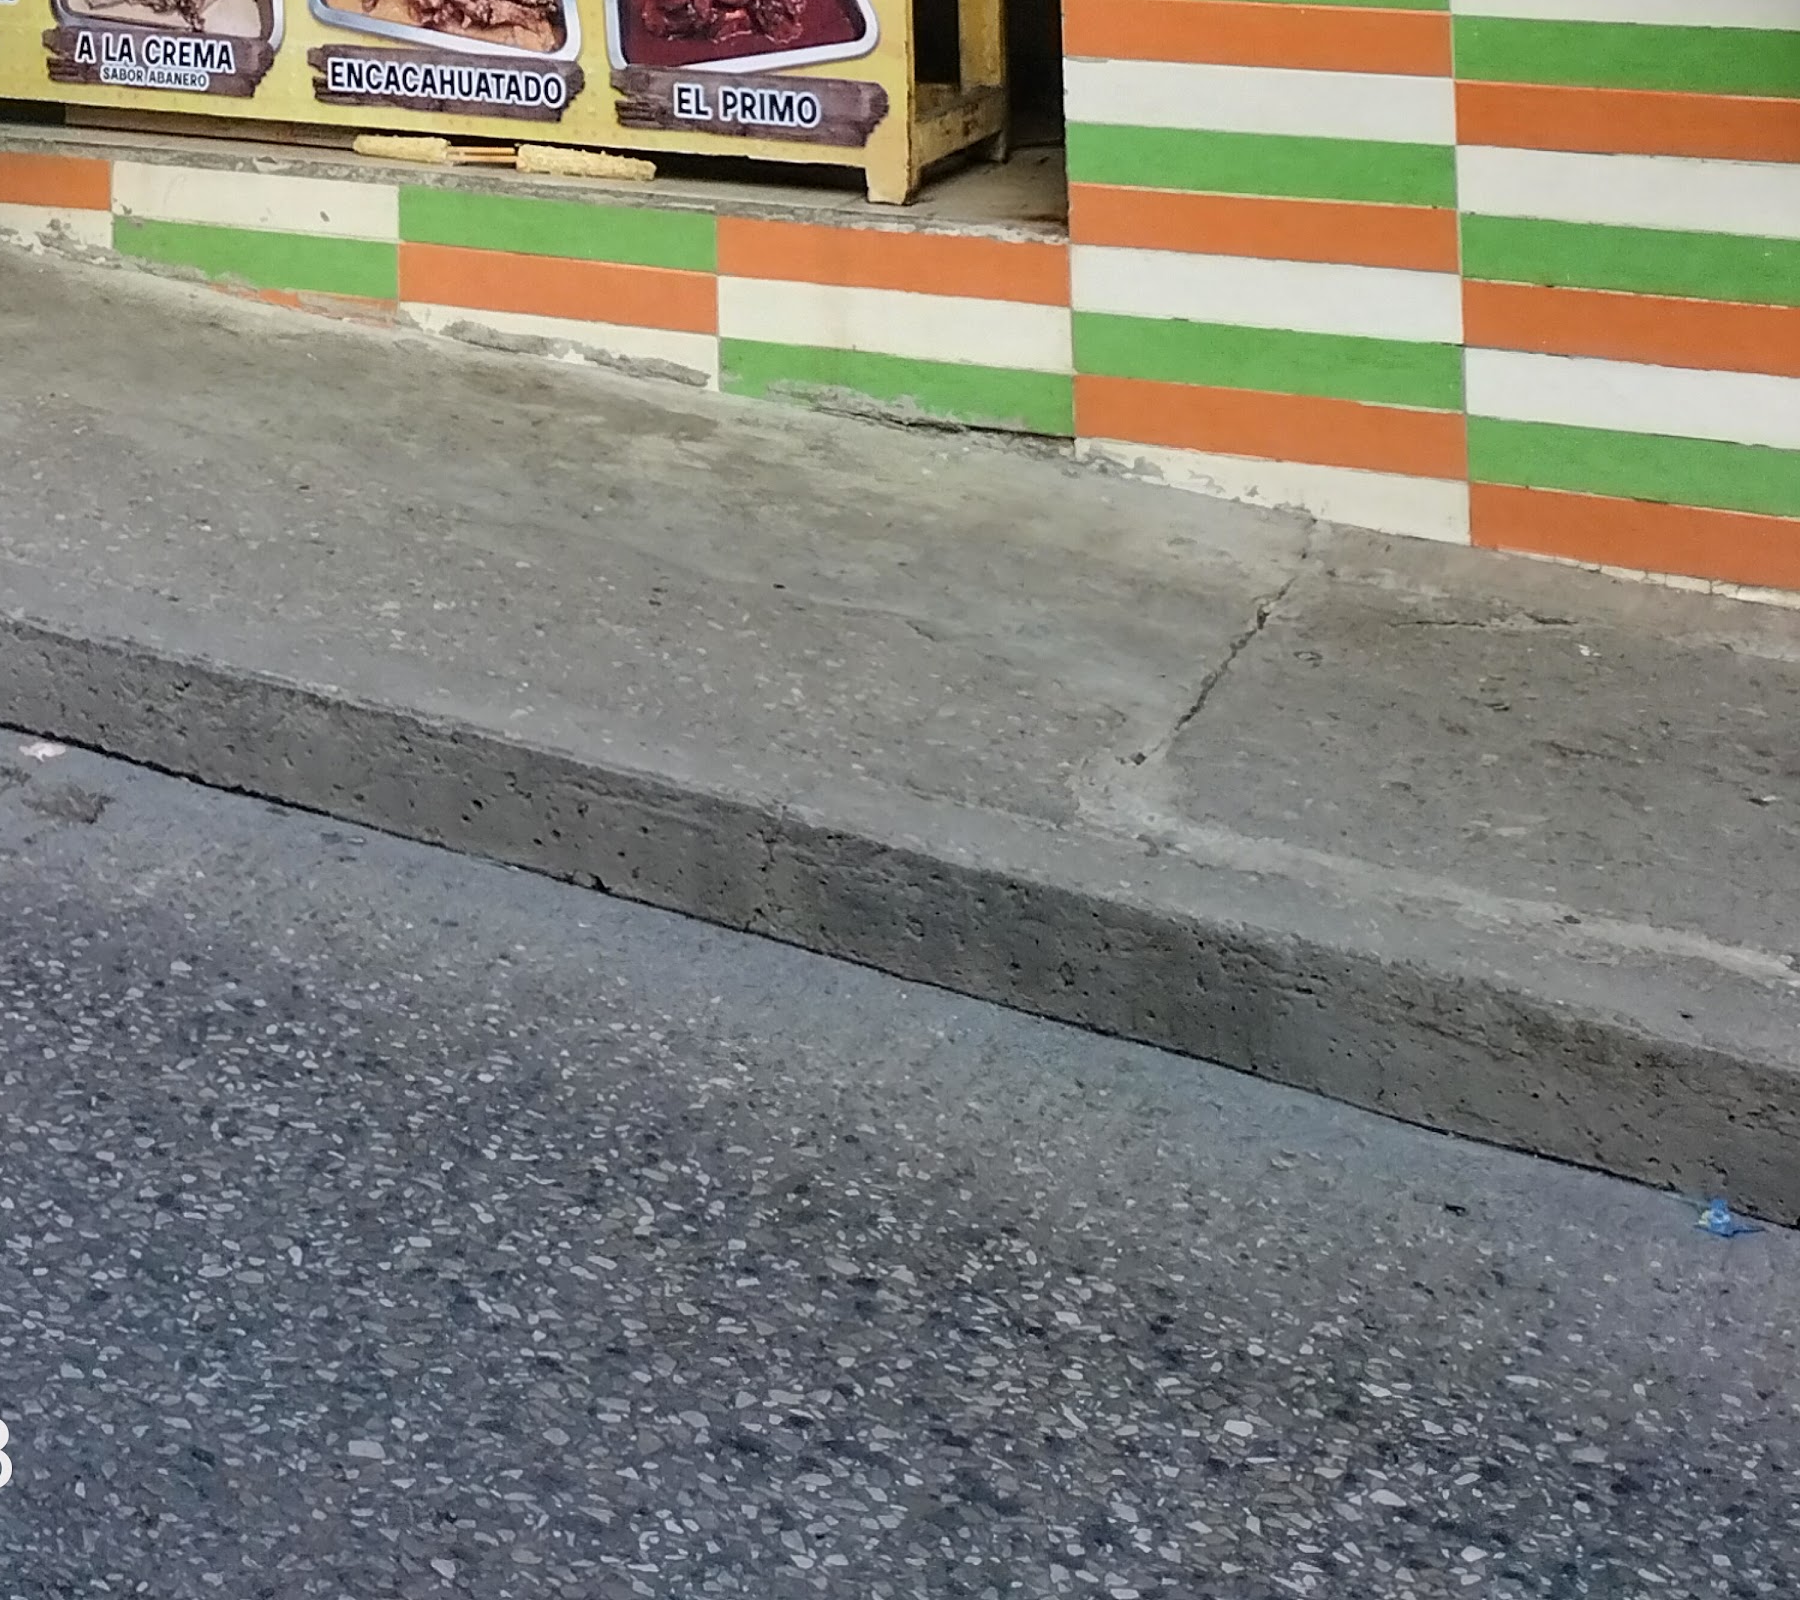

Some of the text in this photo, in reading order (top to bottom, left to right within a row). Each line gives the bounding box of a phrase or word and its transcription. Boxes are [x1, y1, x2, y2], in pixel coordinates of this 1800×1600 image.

[77, 34, 233, 71] A LA CREMA
[102, 66, 207, 88] SABOR ABANERO
[329, 61, 565, 107] ENCACAHUATADO
[675, 85, 819, 126] EL PRIMO
